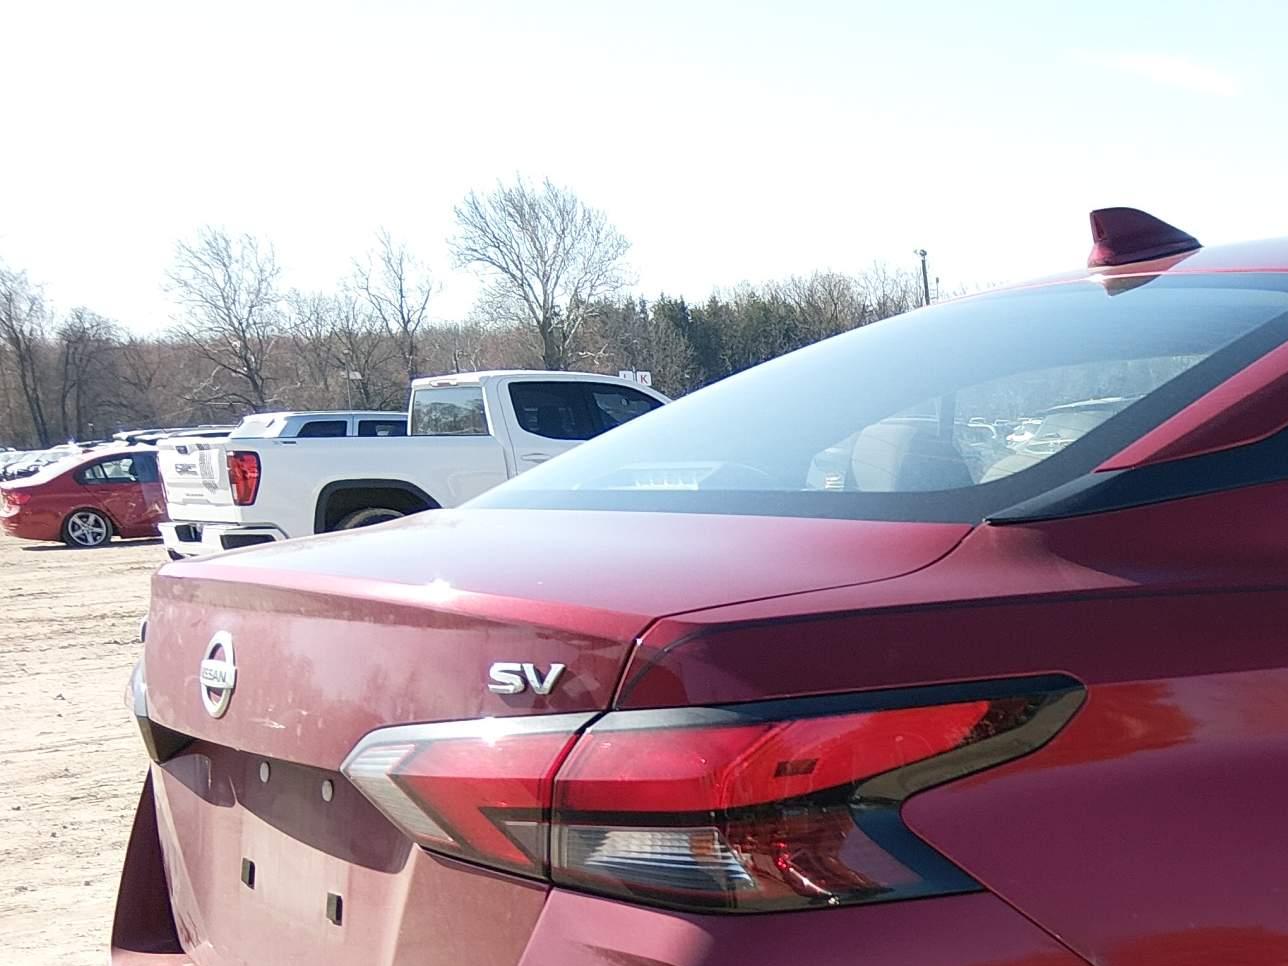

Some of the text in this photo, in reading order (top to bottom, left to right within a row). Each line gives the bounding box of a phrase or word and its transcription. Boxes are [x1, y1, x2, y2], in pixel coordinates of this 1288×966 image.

[640, 374, 648, 384] K
[201, 667, 227, 683] SSAN
[487, 661, 566, 695] SV
